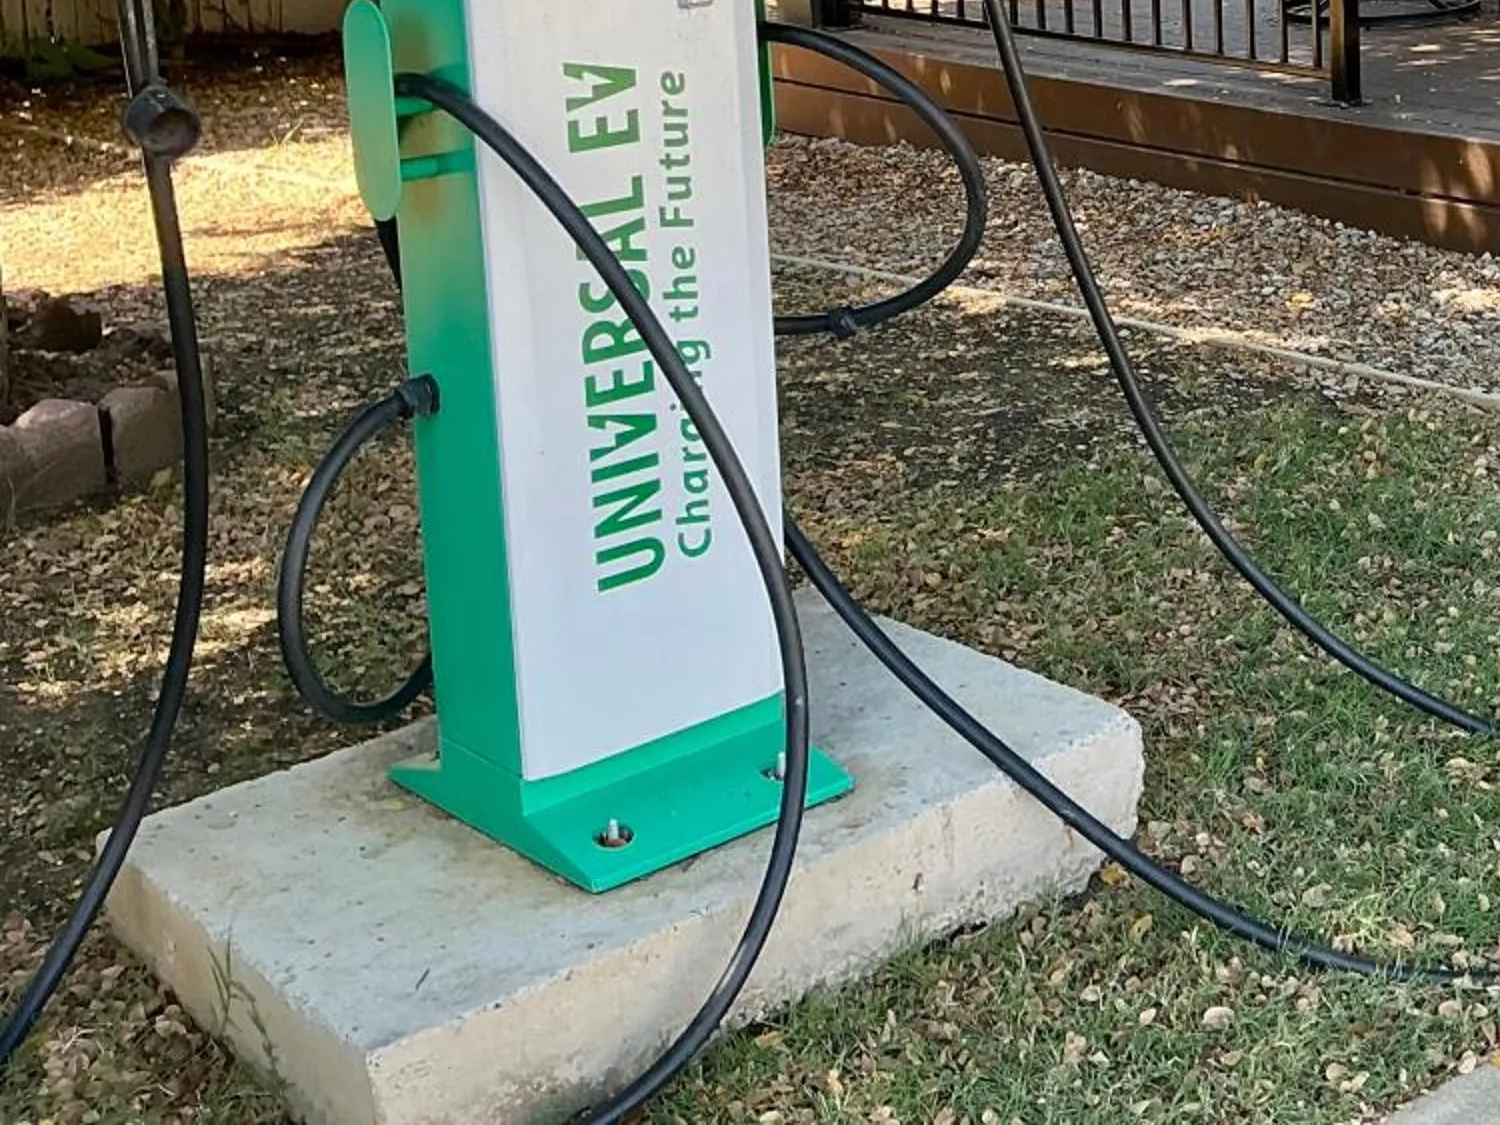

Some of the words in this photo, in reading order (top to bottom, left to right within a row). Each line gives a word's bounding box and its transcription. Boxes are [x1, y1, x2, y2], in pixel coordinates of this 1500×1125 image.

[563, 61, 641, 153] EV
[659, 70, 696, 228] Future
[663, 245, 699, 323] the
[575, 174, 667, 593] UNIVERSAL
[670, 339, 712, 559] Charg
